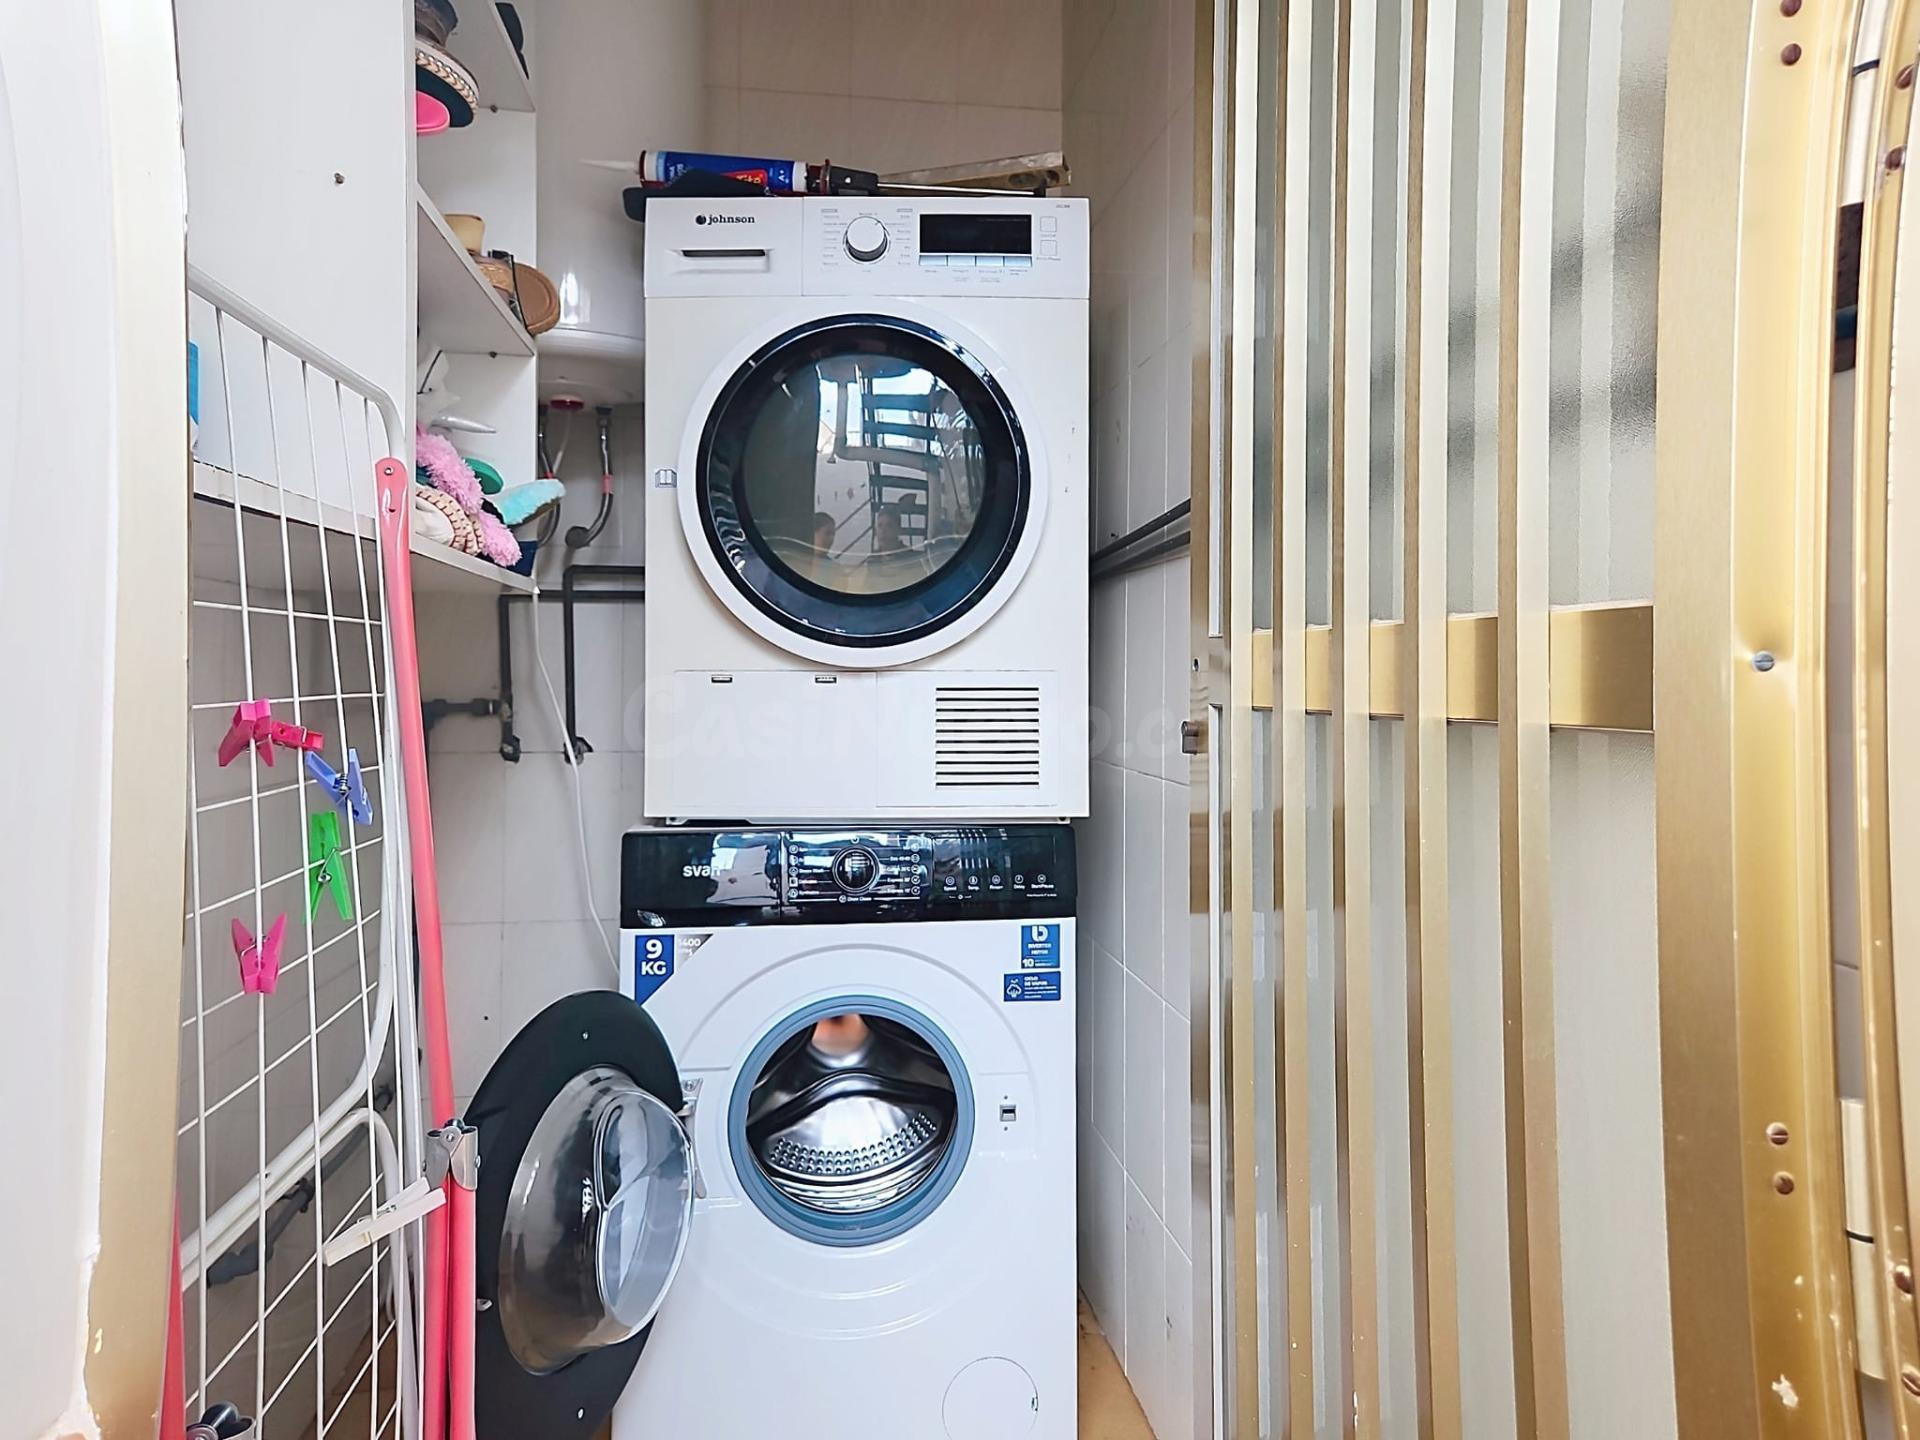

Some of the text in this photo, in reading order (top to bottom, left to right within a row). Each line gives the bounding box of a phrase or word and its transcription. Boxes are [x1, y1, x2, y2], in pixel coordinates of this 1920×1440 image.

[707, 214, 756, 226] johnson
[682, 864, 721, 878] svan
[645, 938, 664, 960] 9
[641, 961, 668, 976] KG
[1022, 958, 1035, 968] 10
